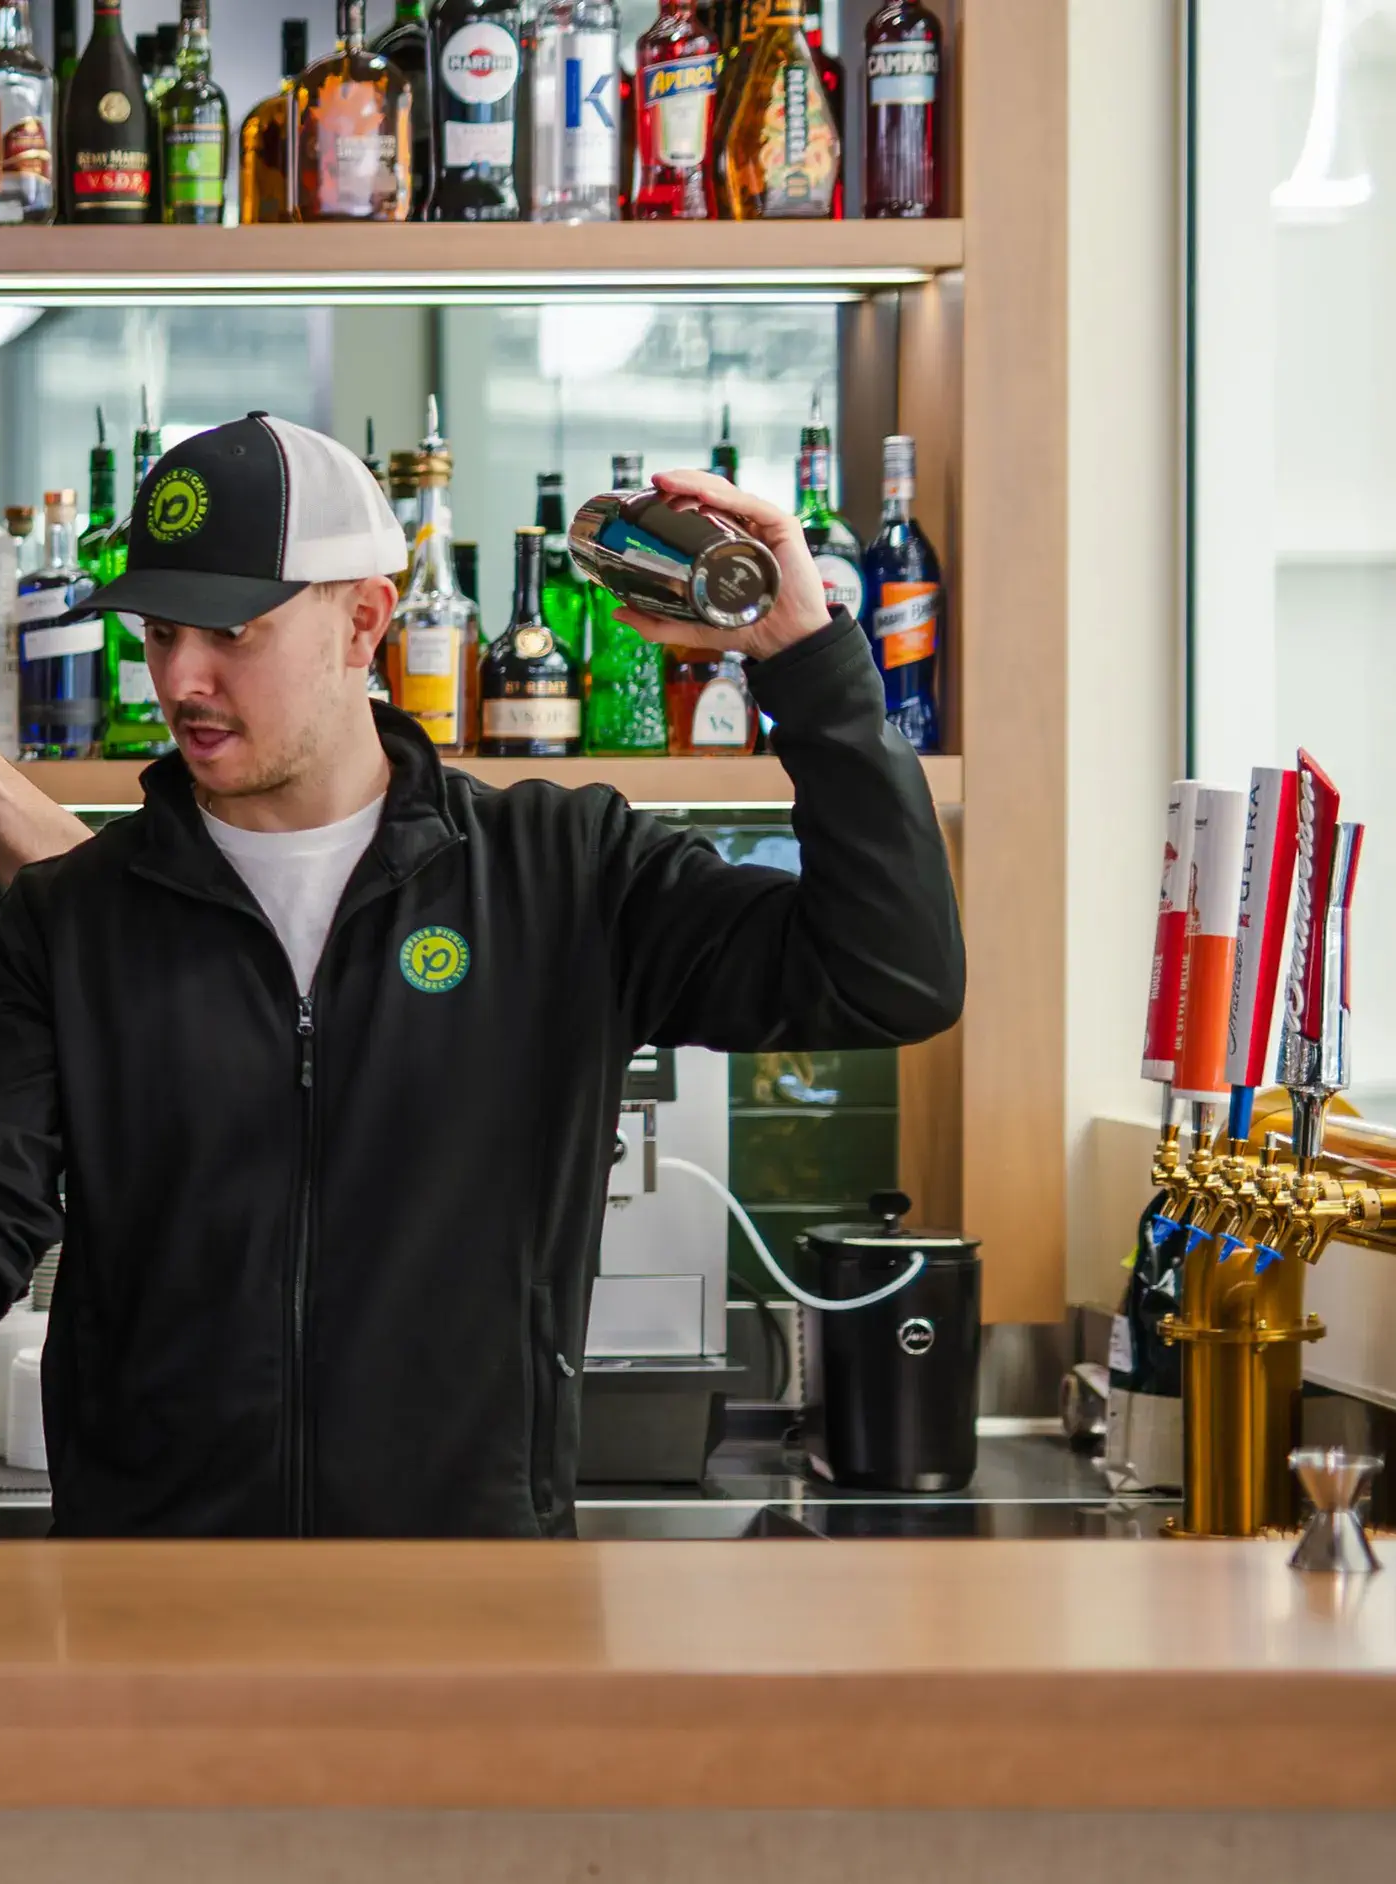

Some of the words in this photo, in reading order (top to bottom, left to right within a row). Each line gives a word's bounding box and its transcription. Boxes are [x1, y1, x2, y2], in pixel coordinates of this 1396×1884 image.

[648, 55, 724, 98] APEROL
[868, 52, 938, 77] CAMPARI
[1239, 784, 1260, 902] ULTRA
[1284, 769, 1315, 1034] Budweiser
